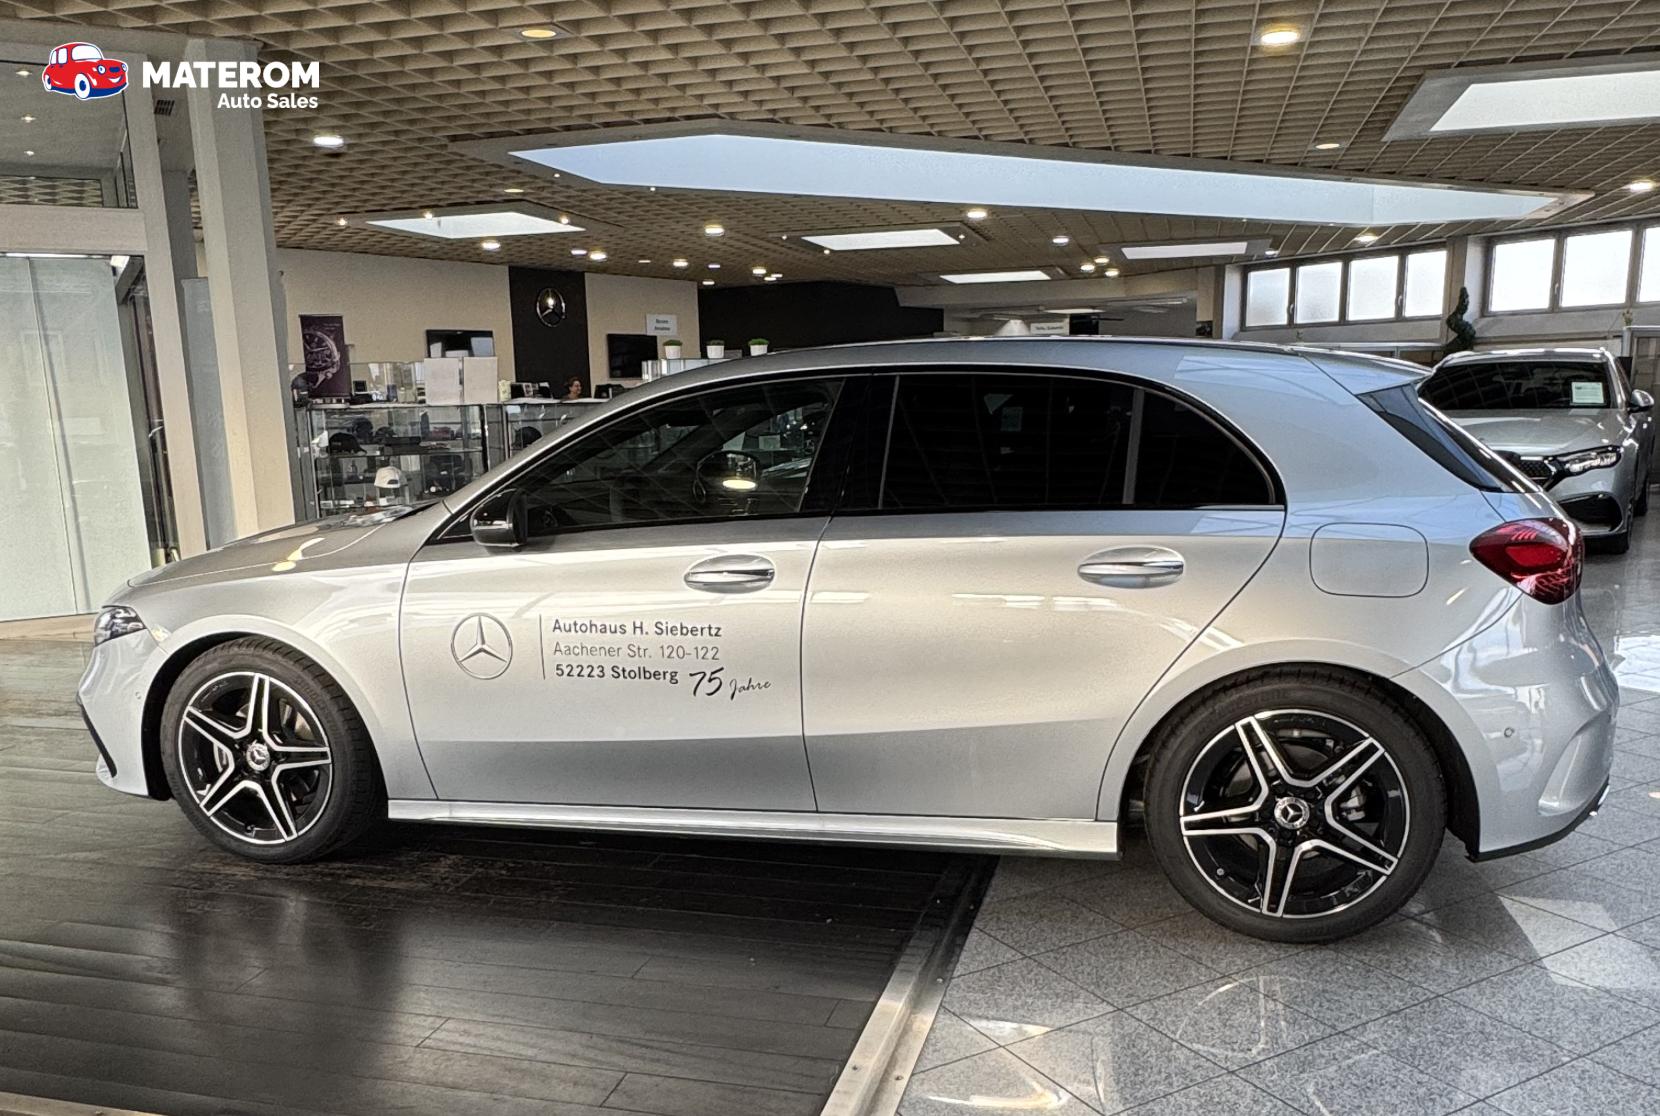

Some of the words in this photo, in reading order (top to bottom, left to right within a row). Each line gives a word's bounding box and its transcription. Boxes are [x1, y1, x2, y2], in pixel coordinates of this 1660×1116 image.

[552, 619, 627, 635] Autohaus
[633, 621, 649, 636] H.
[654, 621, 722, 638] Siebertz
[553, 641, 622, 658] Aachener
[627, 643, 653, 659] Str.
[660, 644, 720, 661] 120-122
[555, 664, 605, 679] 52223
[611, 665, 679, 685] Stolberg
[688, 666, 725, 697] 75
[729, 677, 772, 701] Jahre
